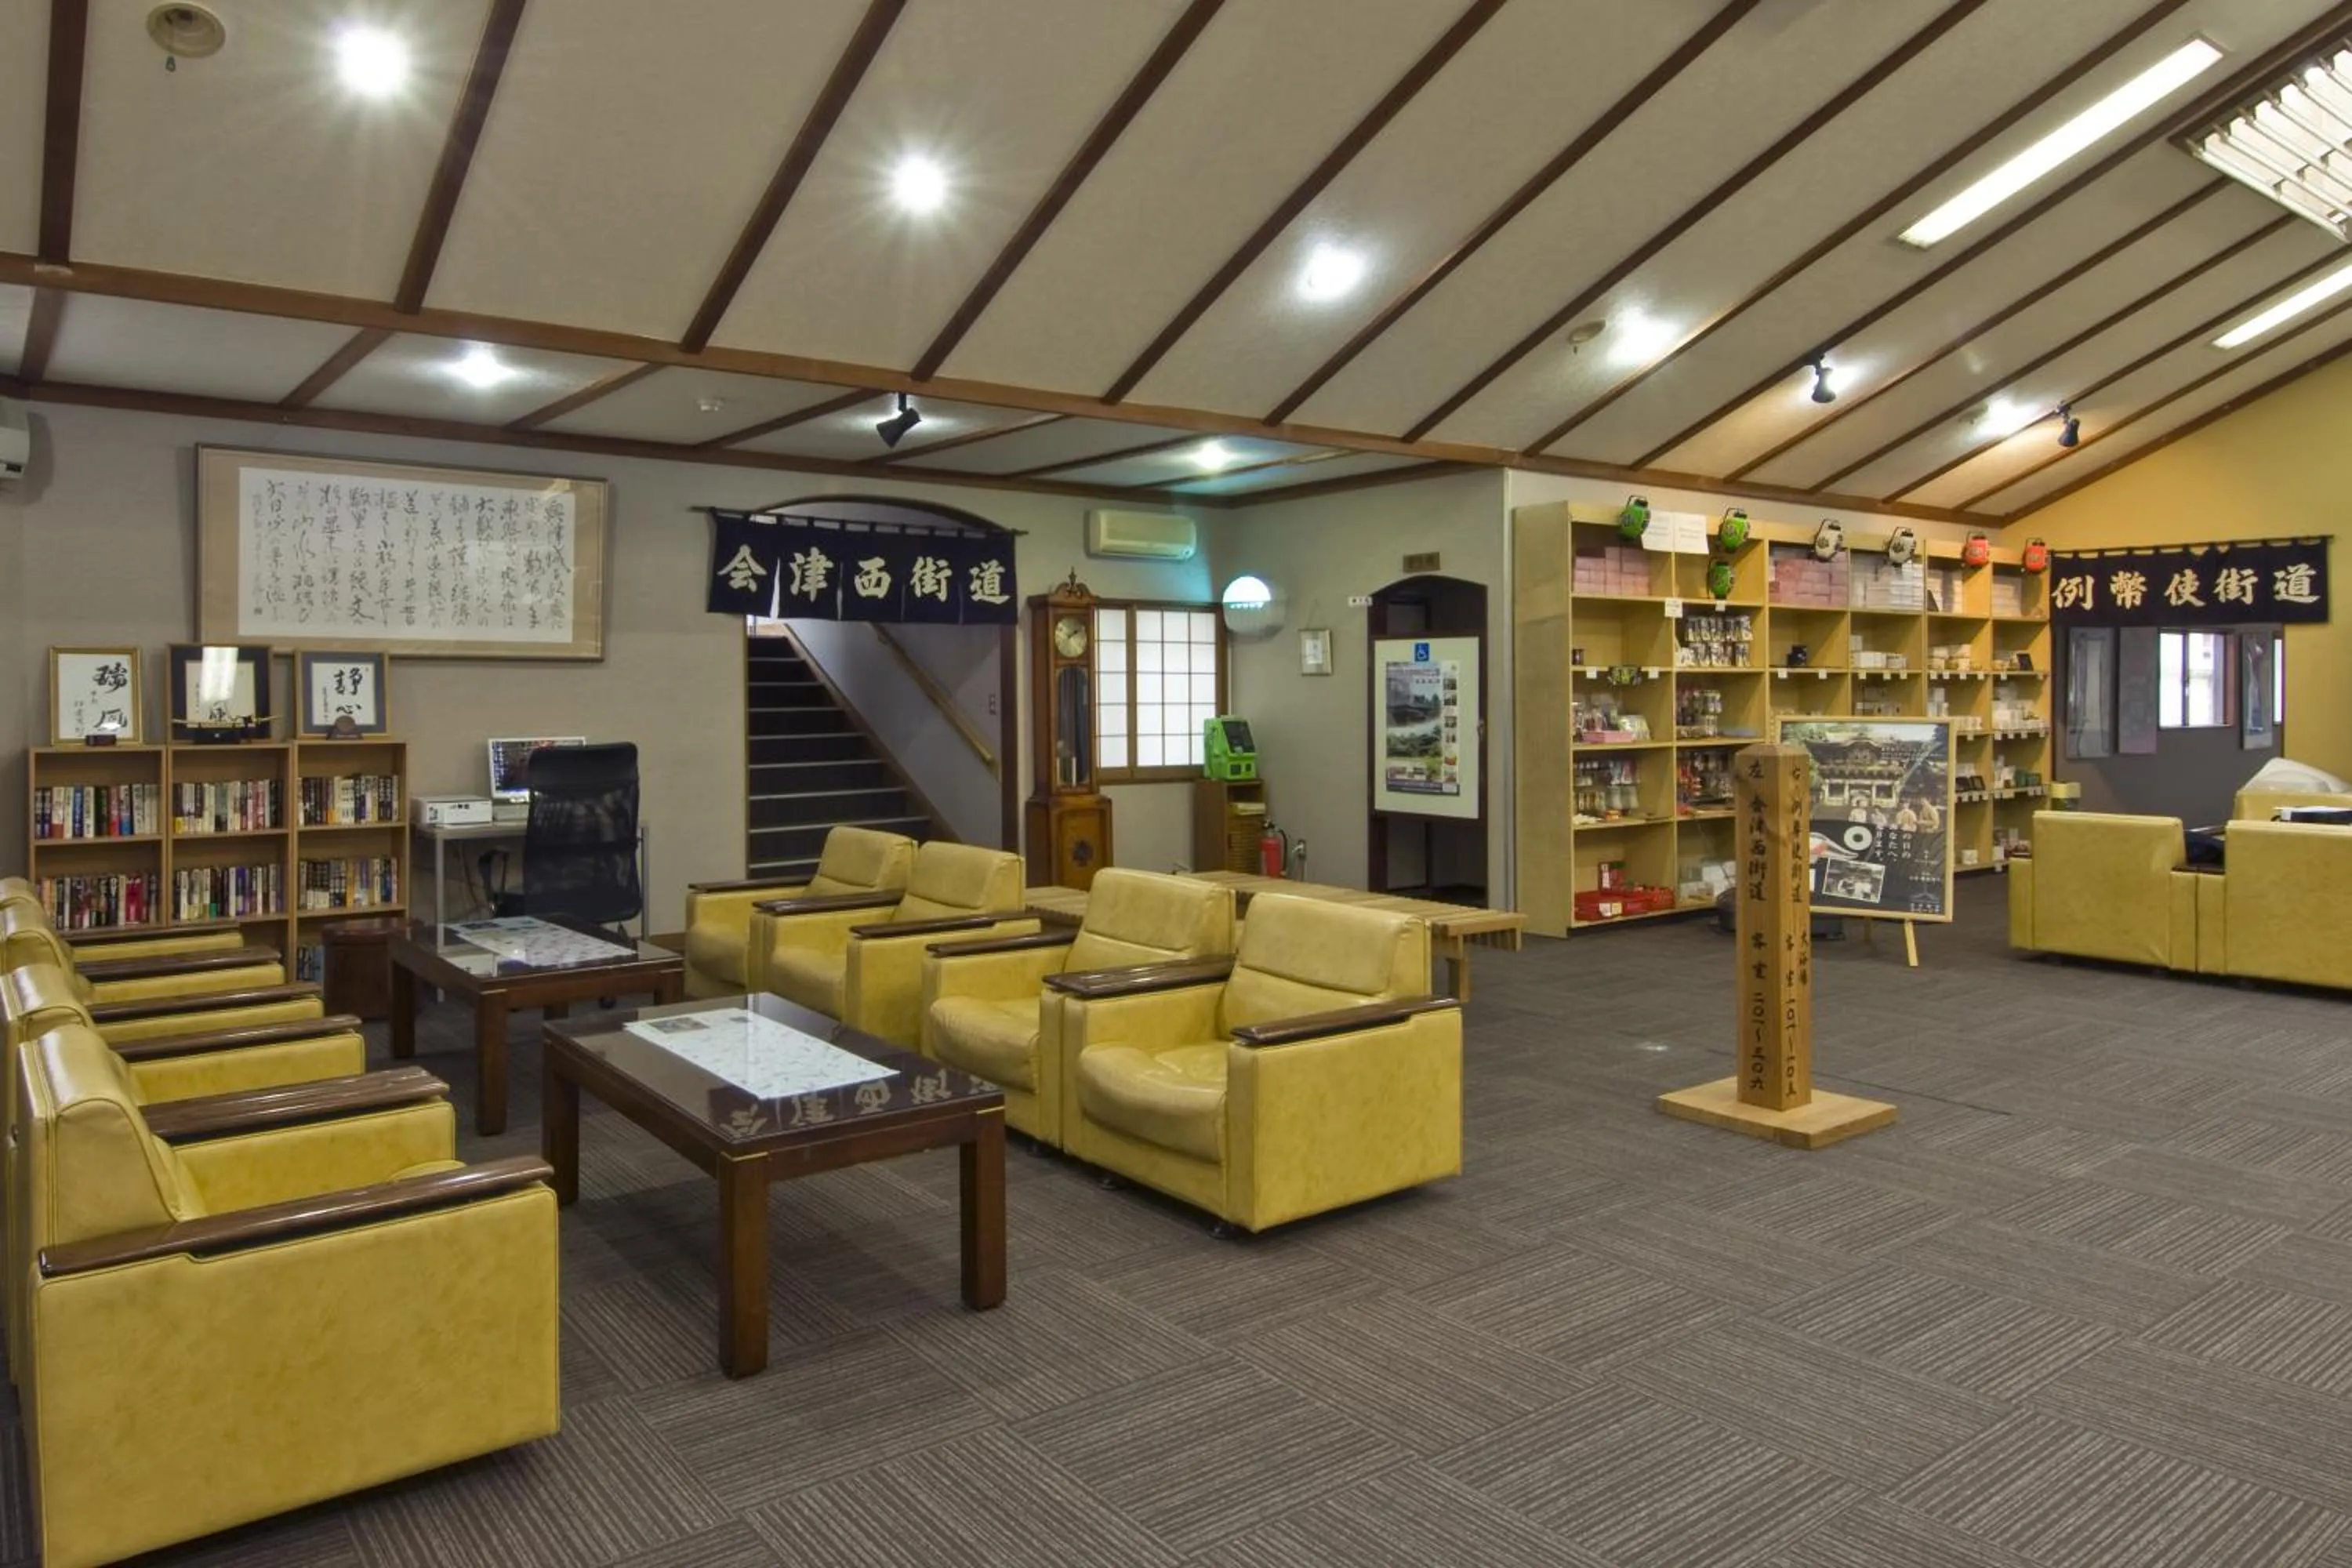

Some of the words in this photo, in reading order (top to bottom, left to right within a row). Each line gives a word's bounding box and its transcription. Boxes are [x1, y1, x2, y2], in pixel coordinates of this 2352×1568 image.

[717, 544, 1011, 604] 会津西街道
[2052, 563, 2321, 611] 例幣使街道
